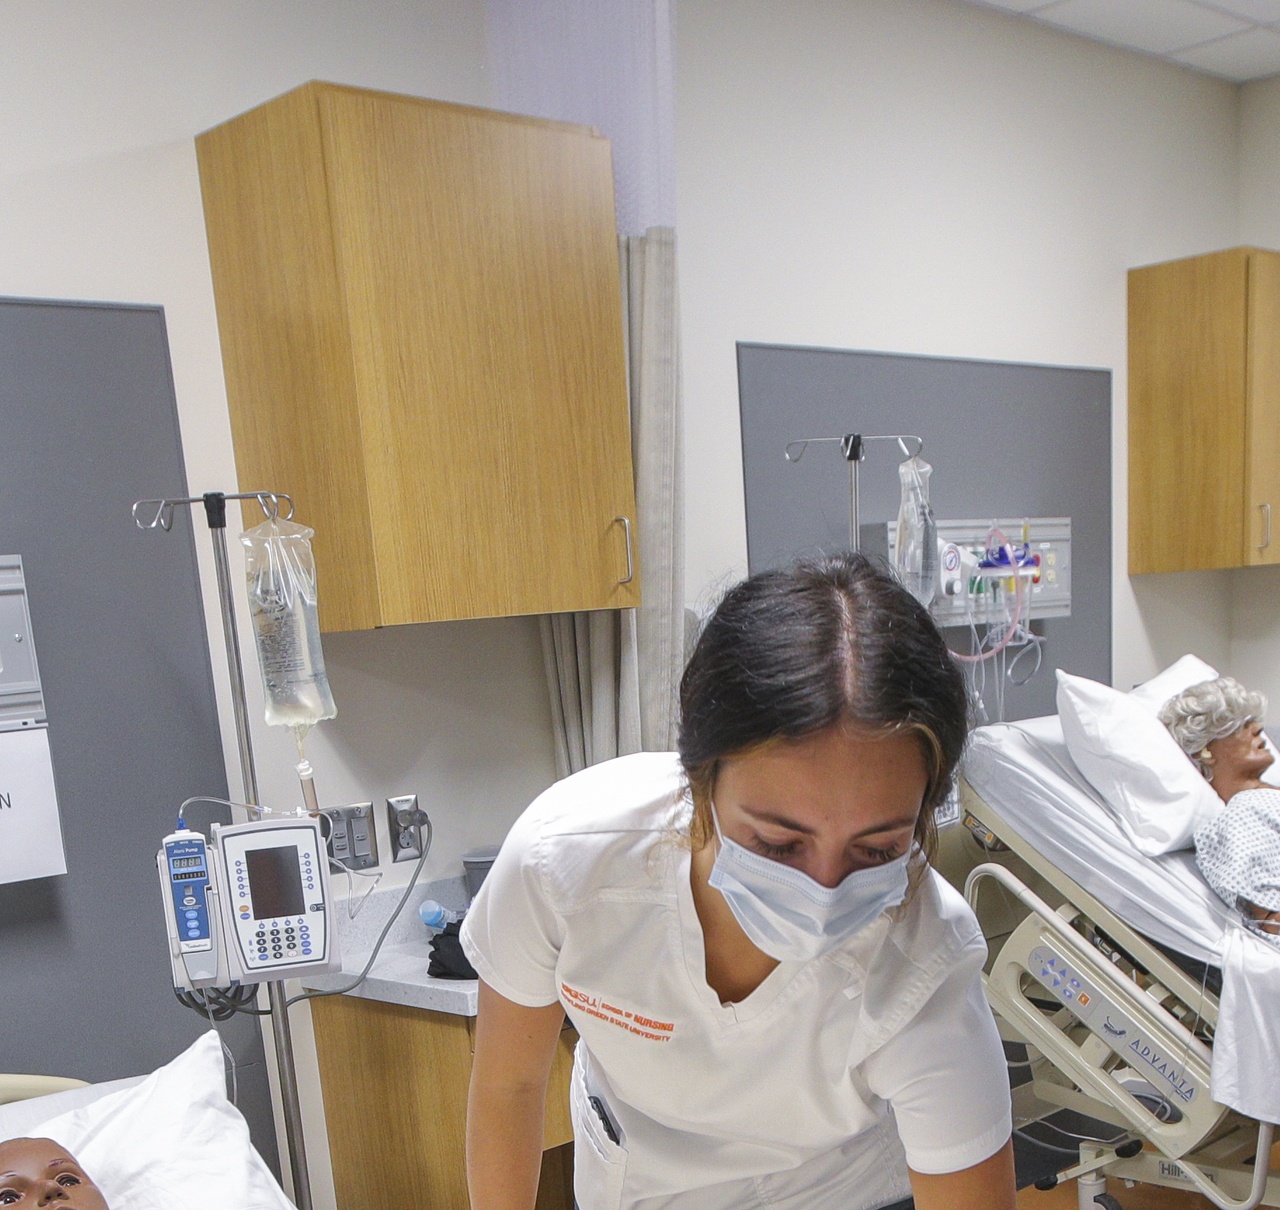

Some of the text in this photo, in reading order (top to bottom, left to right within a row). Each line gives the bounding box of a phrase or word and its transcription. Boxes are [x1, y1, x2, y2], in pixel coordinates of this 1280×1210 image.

[609, 1016, 630, 1031] STATE
[629, 1026, 672, 1042] UNIVERSITY
[633, 1014, 675, 1032] NURSING
[1131, 1039, 1195, 1099] ADVANTA
